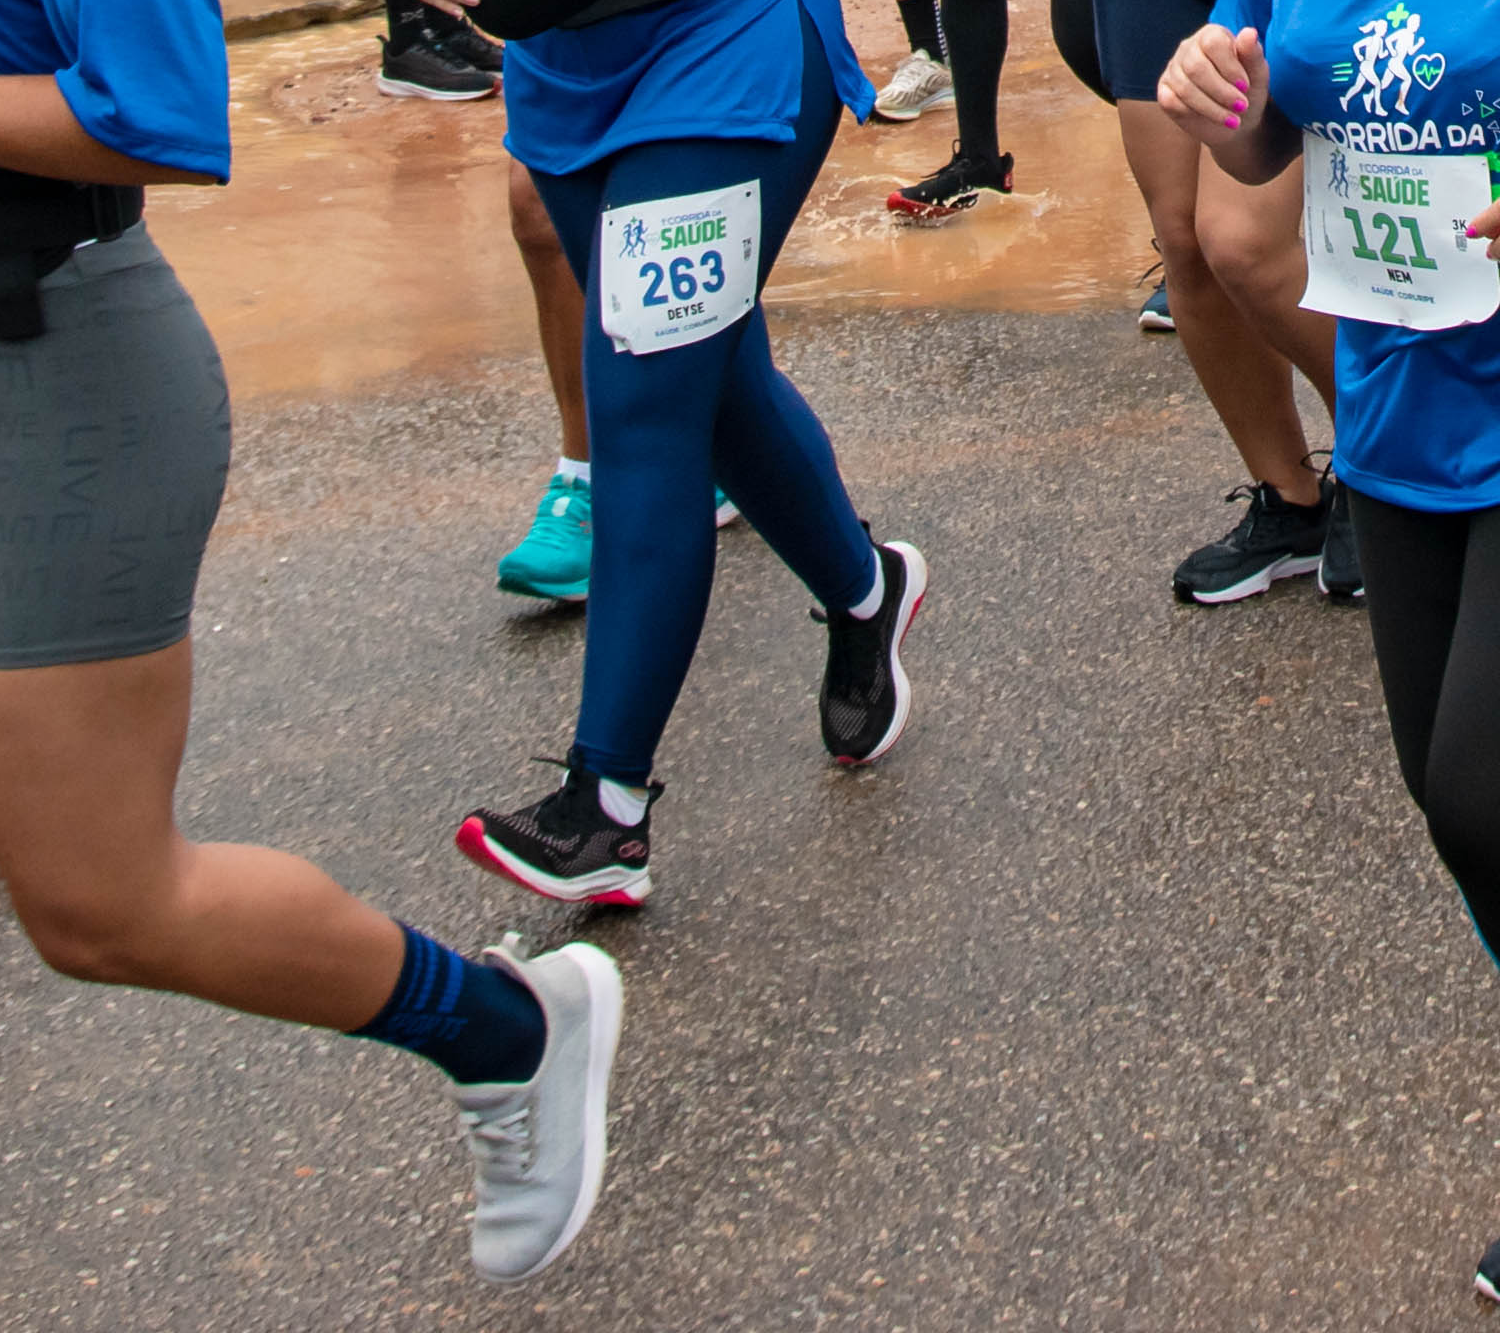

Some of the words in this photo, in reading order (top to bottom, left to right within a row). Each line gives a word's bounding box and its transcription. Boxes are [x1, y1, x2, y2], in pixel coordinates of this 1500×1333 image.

[1446, 124, 1486, 148] DA
[1364, 164, 1412, 175] CORRIDA
[1359, 174, 1430, 207] SAÚDE
[669, 210, 712, 226] CORRIDA
[1452, 219, 1468, 232] 3K
[660, 217, 727, 251] SAÚDE
[1343, 206, 1438, 270] 121
[638, 250, 726, 308] 263
[1387, 268, 1413, 284] NEM
[667, 302, 705, 321] DEYSE
